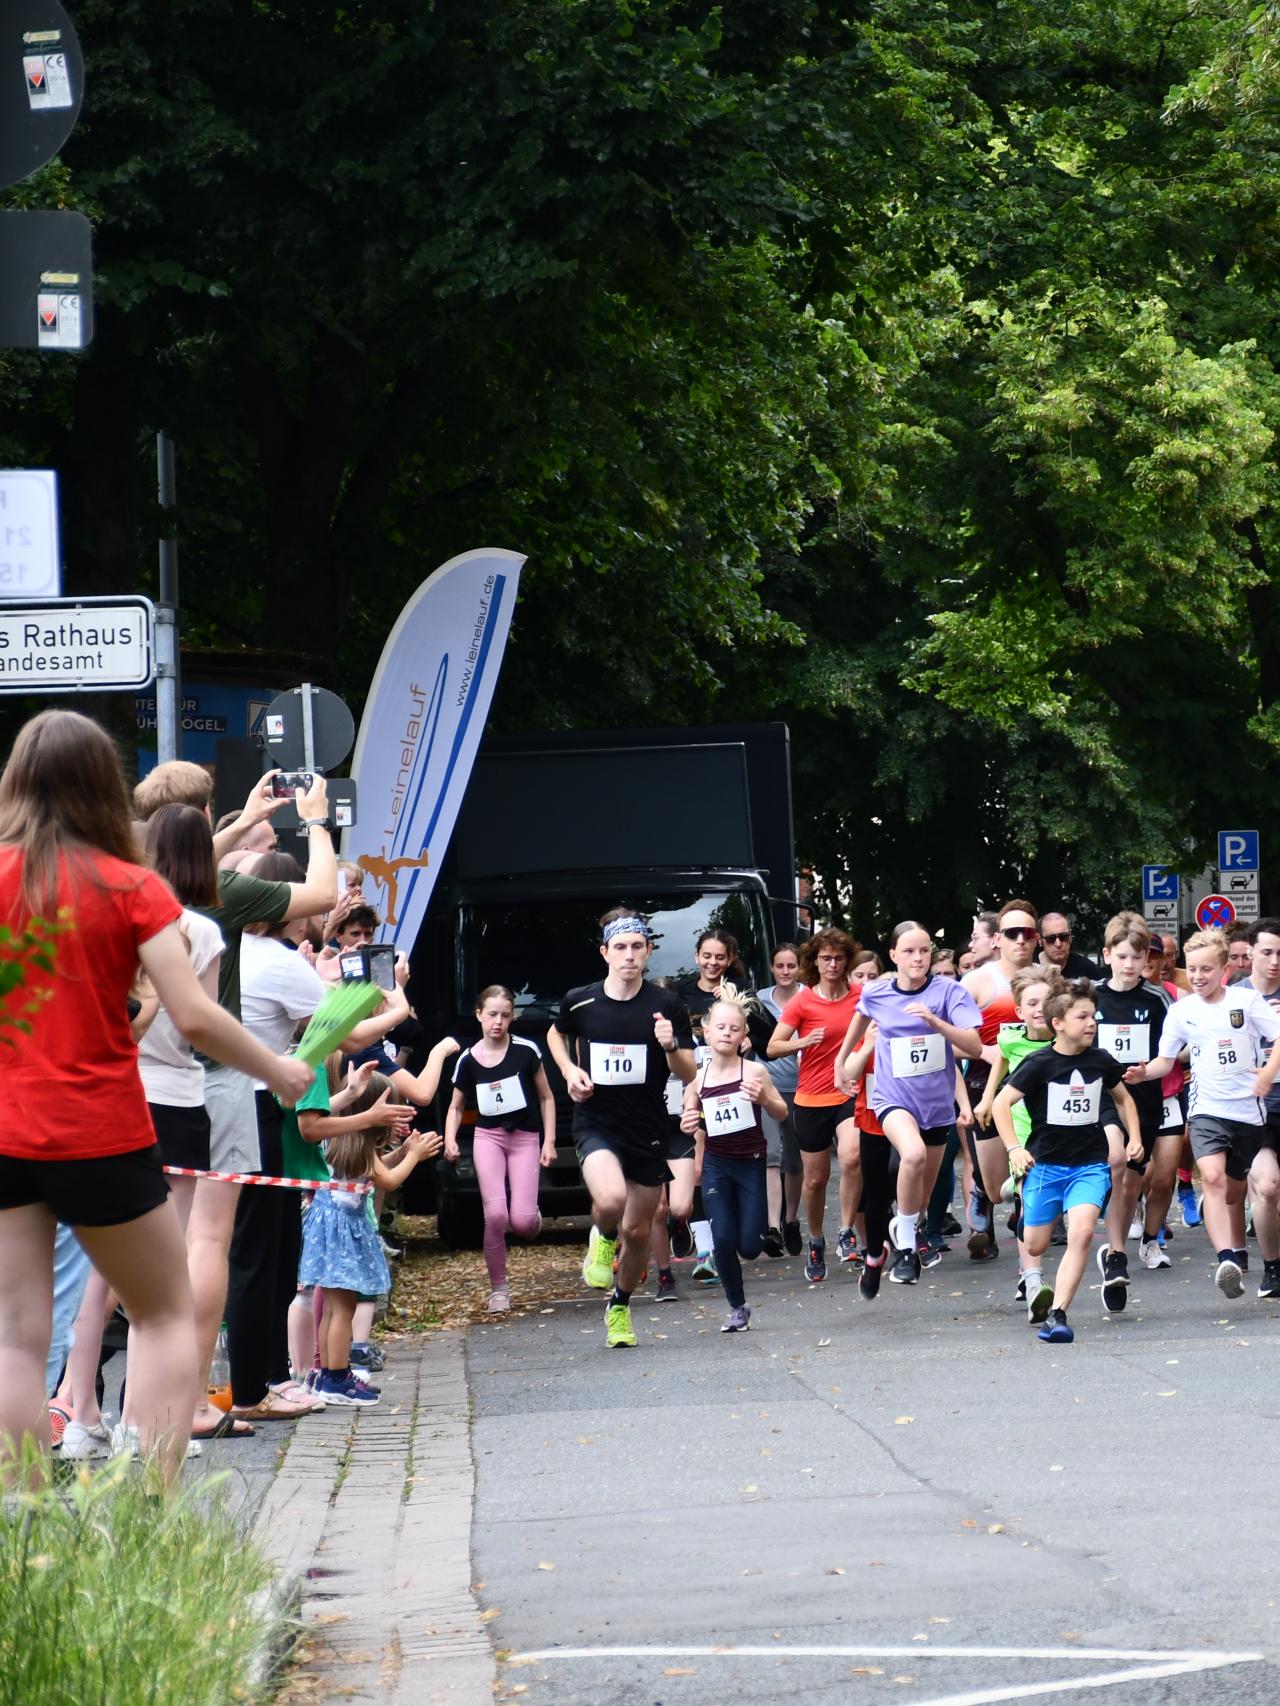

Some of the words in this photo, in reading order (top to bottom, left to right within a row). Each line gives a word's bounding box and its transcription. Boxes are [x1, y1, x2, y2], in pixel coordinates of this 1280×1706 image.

[24, 623, 132, 648] Rathaus
[456, 575, 494, 706] www.leinelauf.de
[384, 682, 427, 835] Leinelauf
[1225, 836, 1246, 866] P
[1115, 1038, 1131, 1052] 91
[910, 1049, 928, 1064] 67
[1218, 1050, 1237, 1065] 58
[603, 1058, 632, 1073] 110
[496, 1092, 503, 1103] 4
[1062, 1098, 1090, 1113] 453
[715, 1106, 739, 1123] 441
